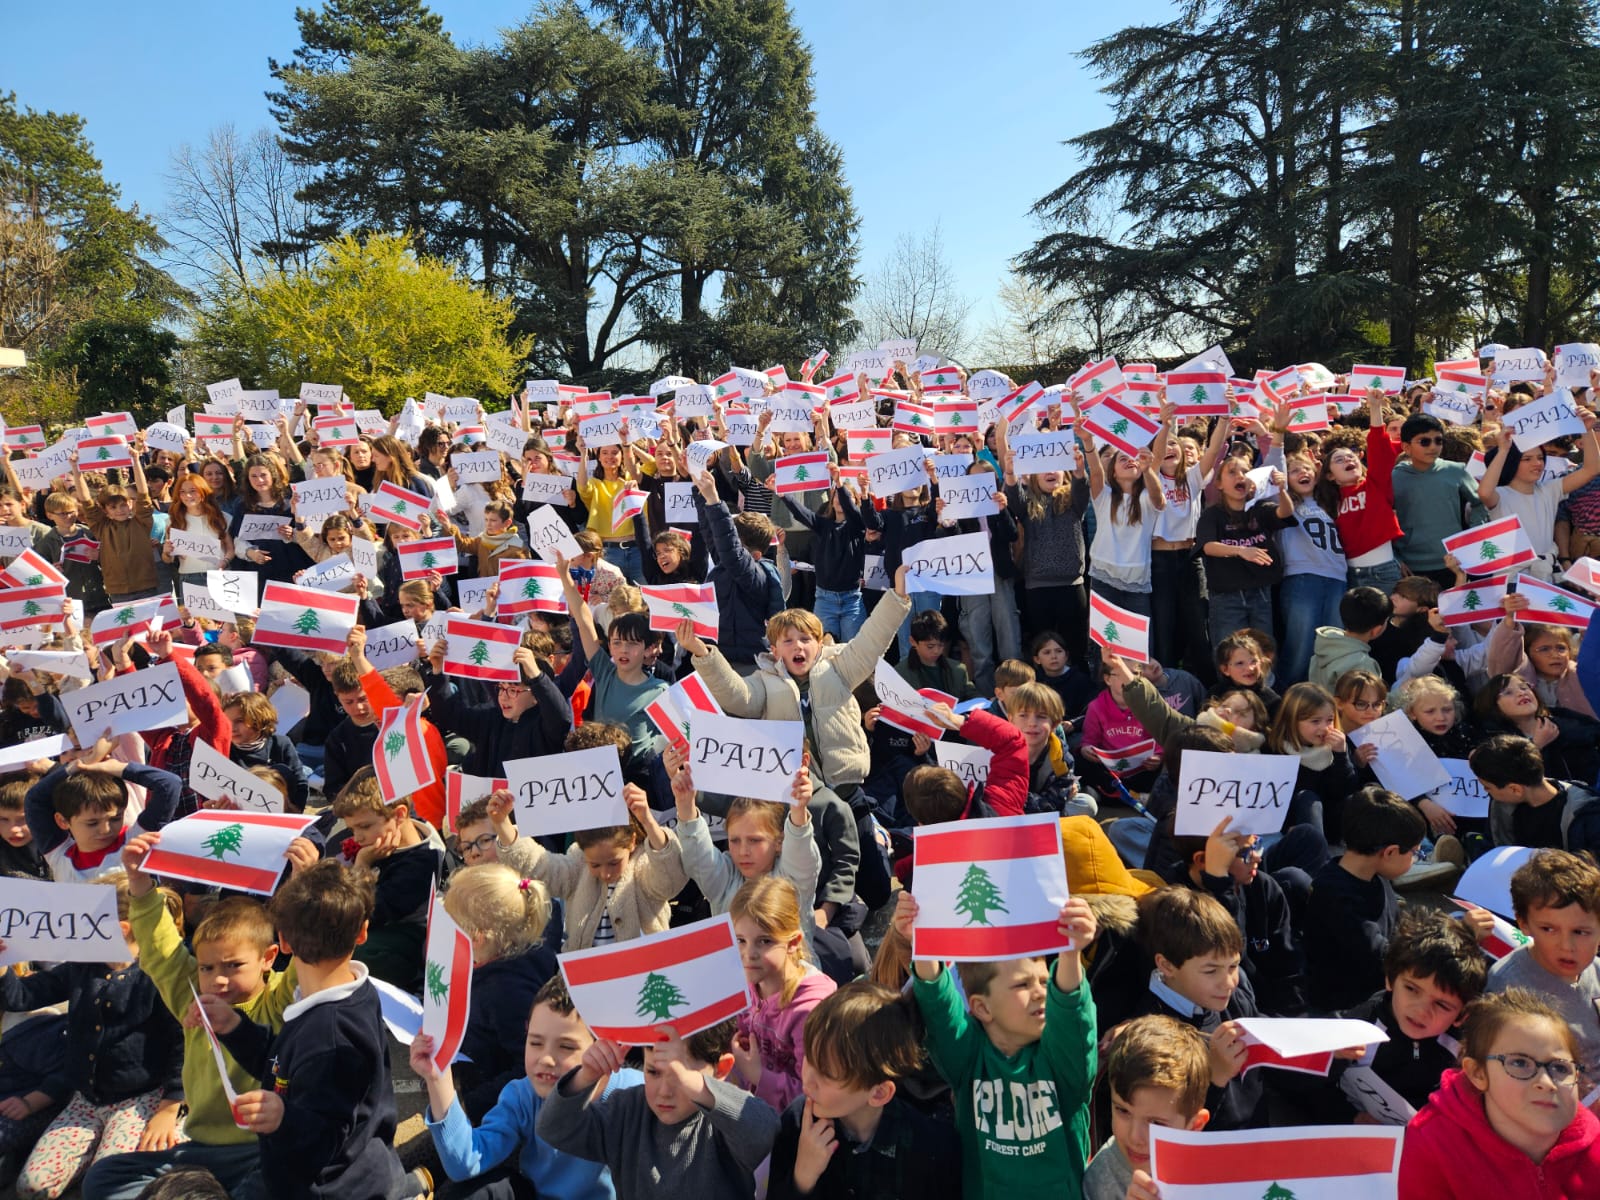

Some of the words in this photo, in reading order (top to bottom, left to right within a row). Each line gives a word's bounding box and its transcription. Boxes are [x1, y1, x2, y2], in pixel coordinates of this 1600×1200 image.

[889, 347, 914, 358] AIX
[853, 357, 886, 369] PAIX
[1499, 357, 1545, 371] PAIX
[529, 386, 558, 396] PAIX
[972, 376, 1006, 388] PAIX
[303, 389, 339, 399] PAIX
[679, 393, 713, 406] PAIX
[1435, 392, 1476, 414] PAIX
[240, 397, 278, 411] PAIX
[774, 408, 811, 421] PAIX
[835, 408, 871, 423] PAIX
[1518, 403, 1577, 435] PAIX
[583, 420, 620, 438] PAIX
[629, 417, 660, 431] PAIX
[490, 430, 524, 449] PAIX
[1017, 441, 1071, 459] PAIX
[457, 459, 499, 475] PAIX
[873, 457, 922, 483] PAIX
[301, 485, 344, 504] PAIX
[669, 493, 696, 509] PA
[944, 484, 993, 505] PAIX
[172, 537, 217, 556] PAIX
[910, 551, 986, 578] PAIX
[302, 562, 350, 587] PAIX
[364, 633, 415, 658] PAIX
[77, 680, 177, 724] PAIX
[1106, 726, 1144, 738] ATHLETIC
[696, 737, 796, 776] PAIX
[196, 761, 280, 813] PAIX
[519, 771, 617, 809] PAIX
[1188, 777, 1289, 809] PAIX
[0, 907, 113, 941] PAIX
[1022, 1140, 1047, 1157] CAMP
